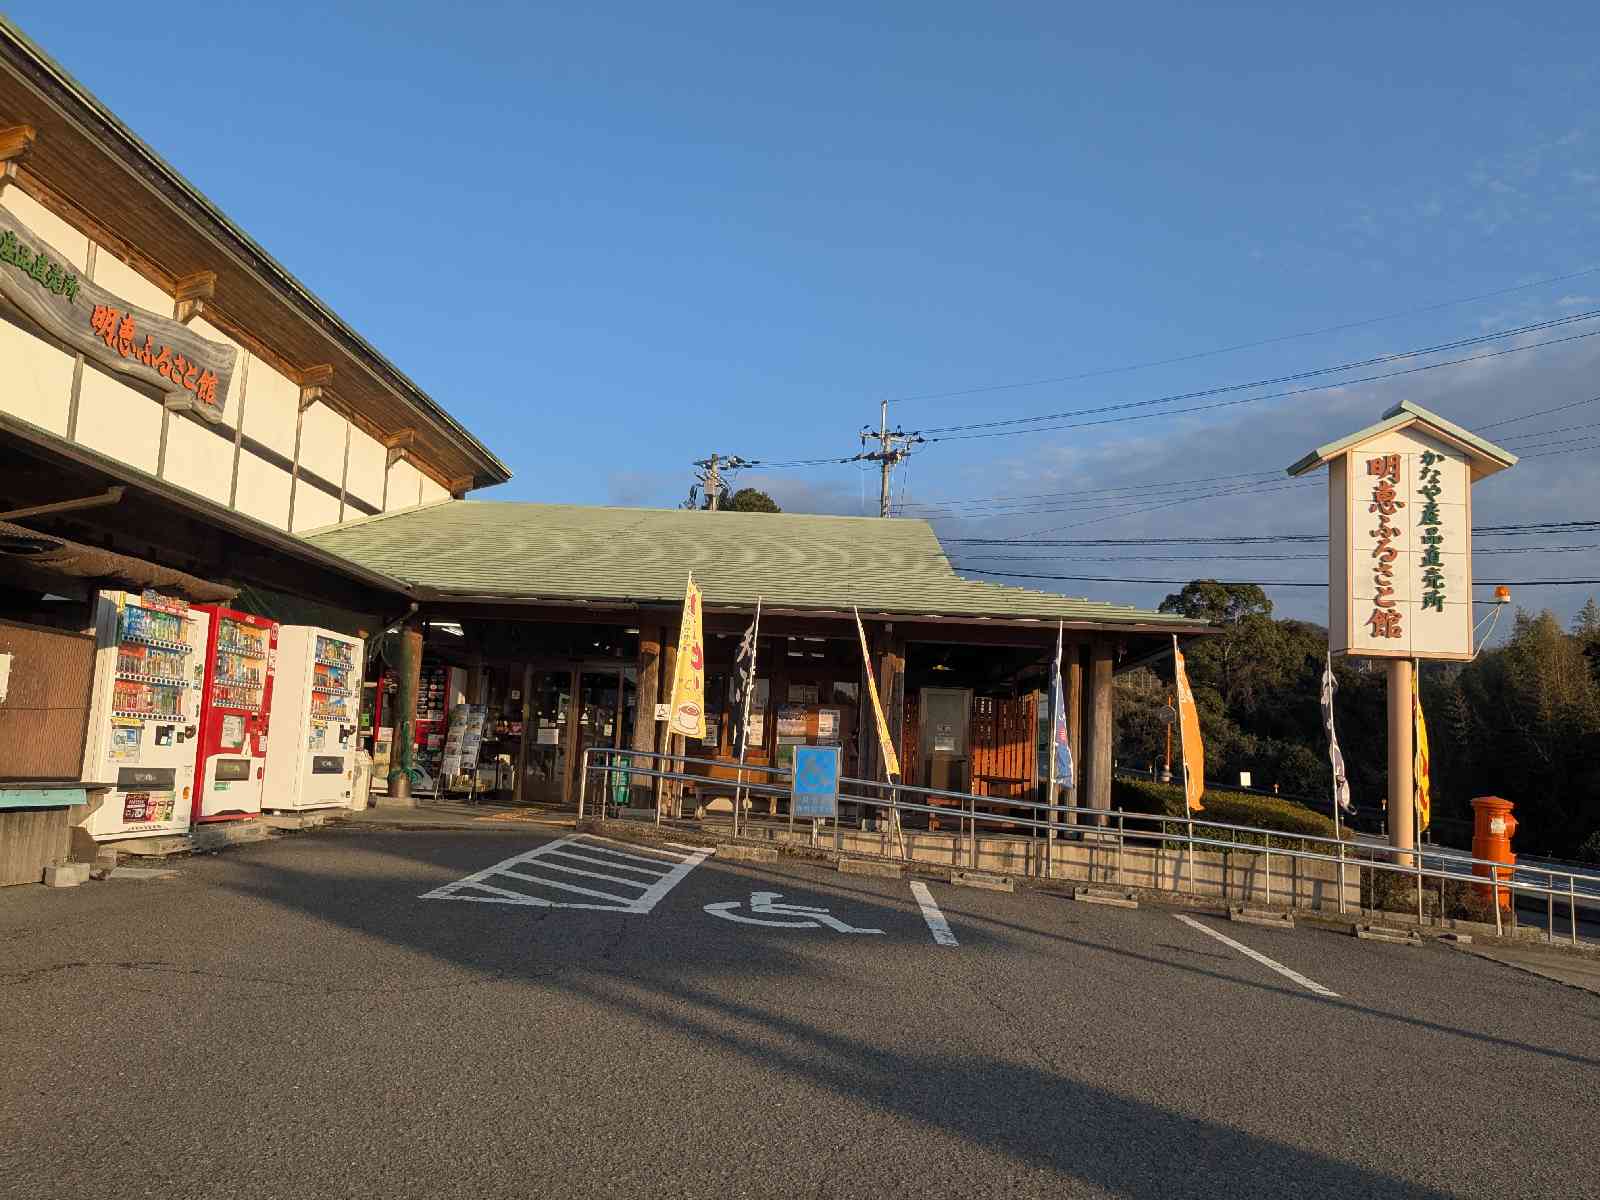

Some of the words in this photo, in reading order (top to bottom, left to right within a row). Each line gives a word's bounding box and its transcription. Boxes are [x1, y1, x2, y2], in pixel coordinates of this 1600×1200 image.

[1366, 453, 1405, 638] 明恵ふるさと館
[1417, 450, 1446, 612] かなや産品直売所
